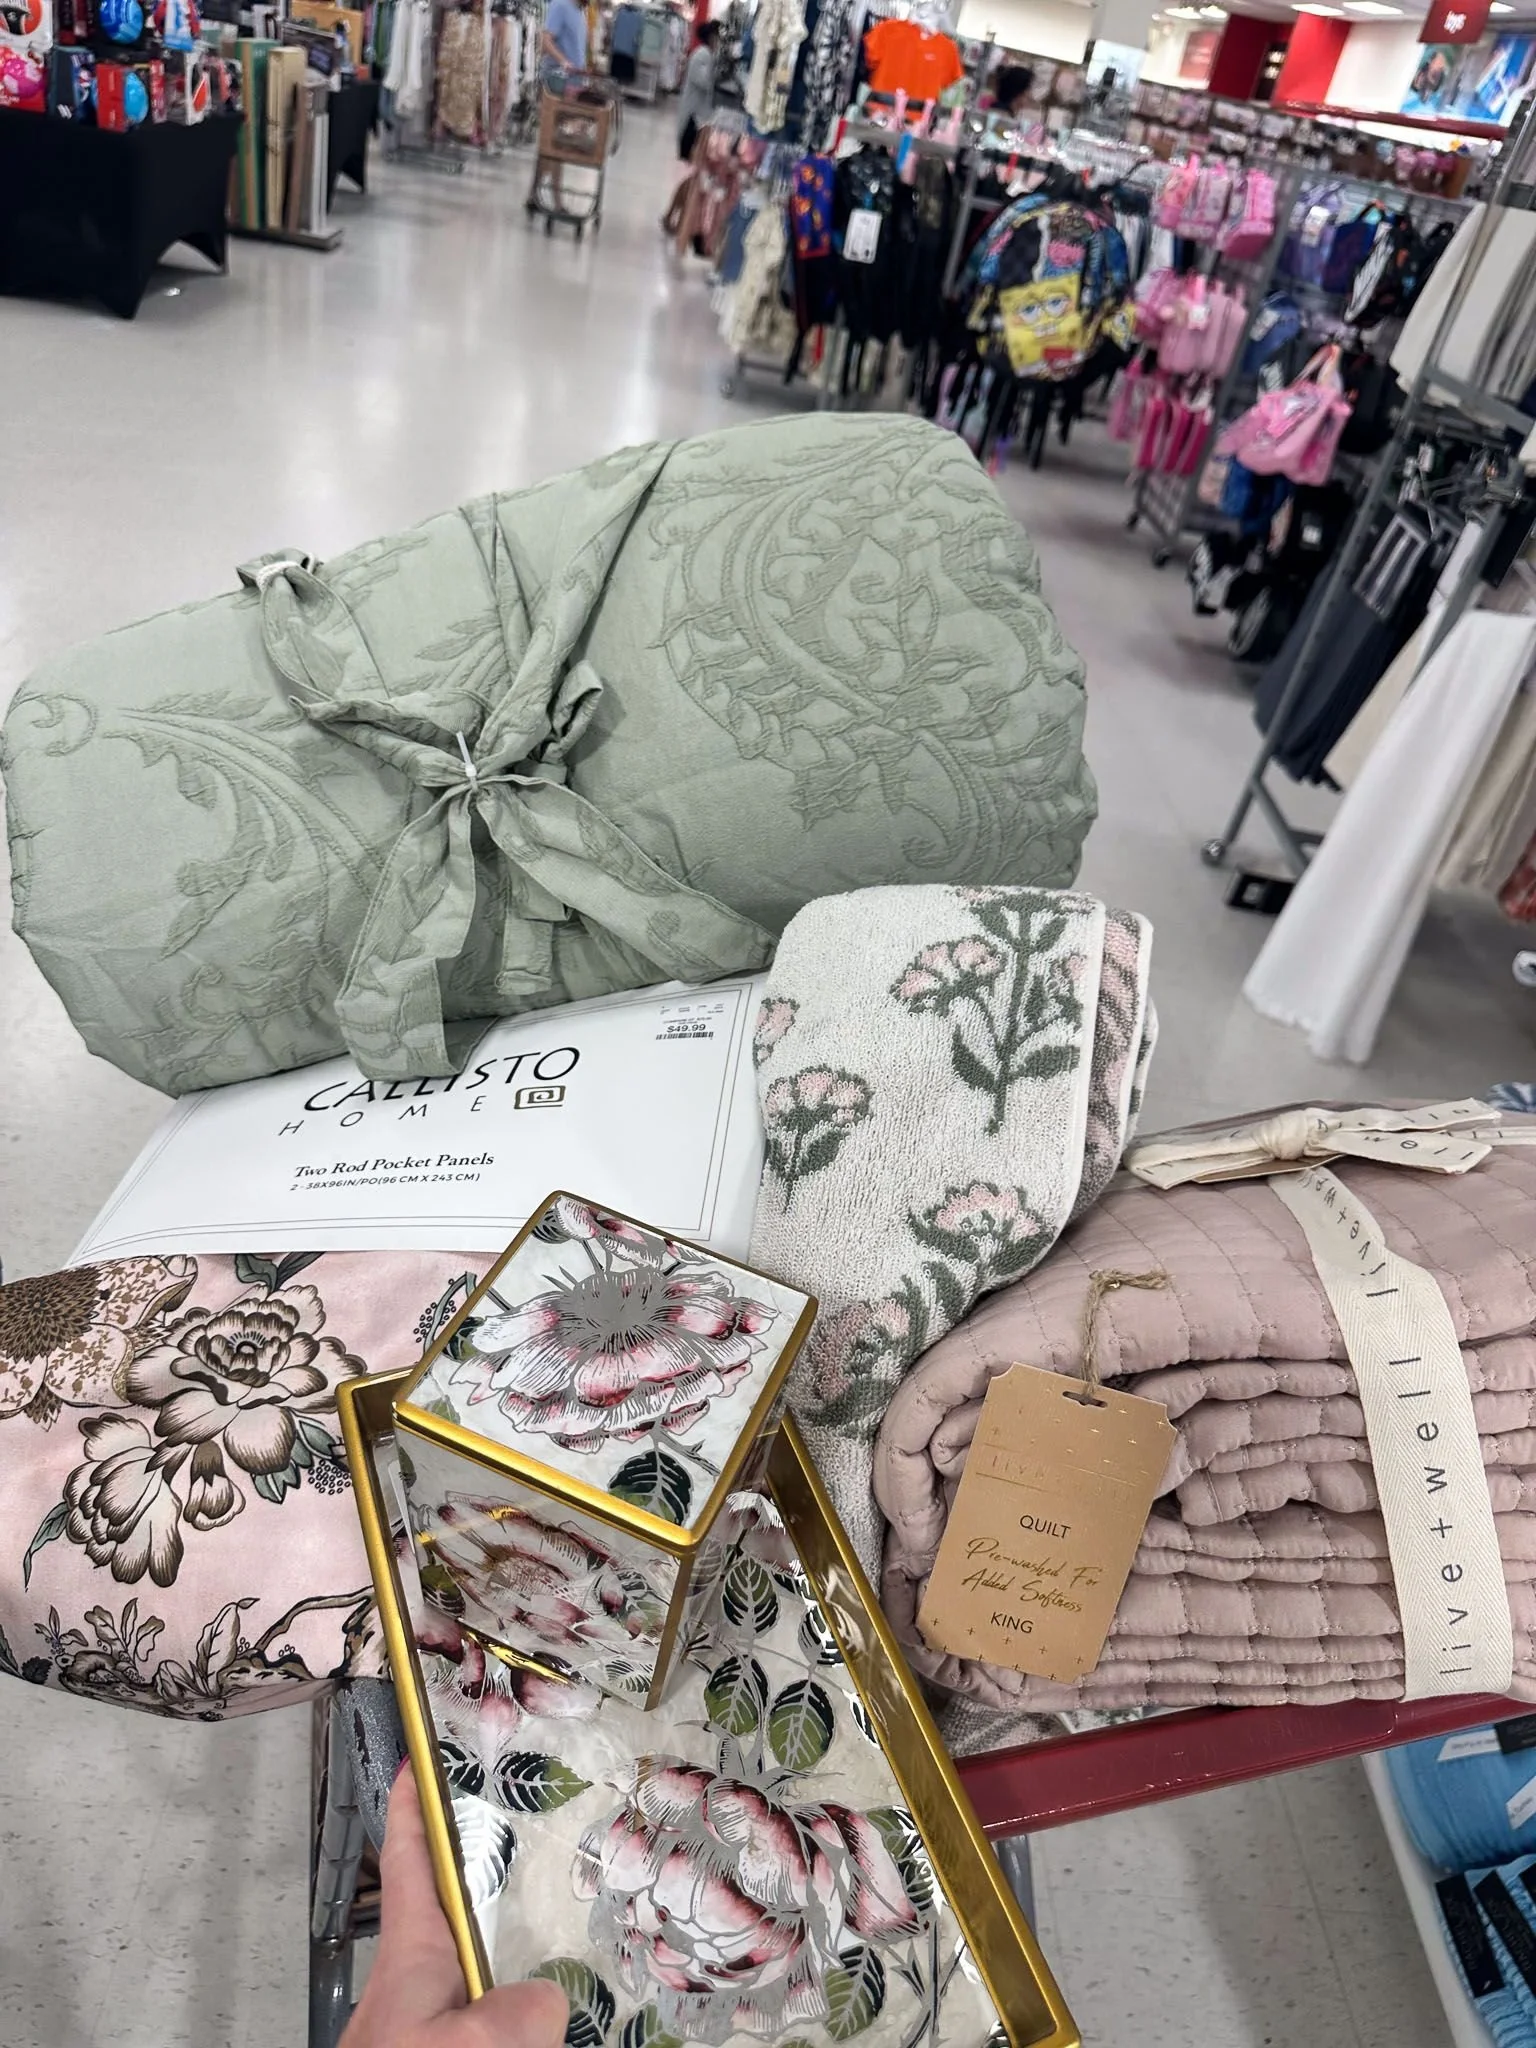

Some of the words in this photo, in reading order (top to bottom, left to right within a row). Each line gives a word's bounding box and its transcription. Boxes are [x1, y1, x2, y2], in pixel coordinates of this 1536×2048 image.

[666, 1023, 706, 1033] $49.99
[294, 1165, 328, 1178] Two
[331, 1159, 369, 1174] Rod
[371, 1156, 432, 1171] Pocket
[436, 1152, 495, 1167] Panels
[1019, 1514, 1071, 1539] QUILT
[965, 1537, 1067, 1577] Pre-washed
[1070, 1566, 1103, 1589] For
[961, 1568, 1016, 1592] Added
[1020, 1580, 1082, 1612] Softness
[990, 1611, 1034, 1634] KING
